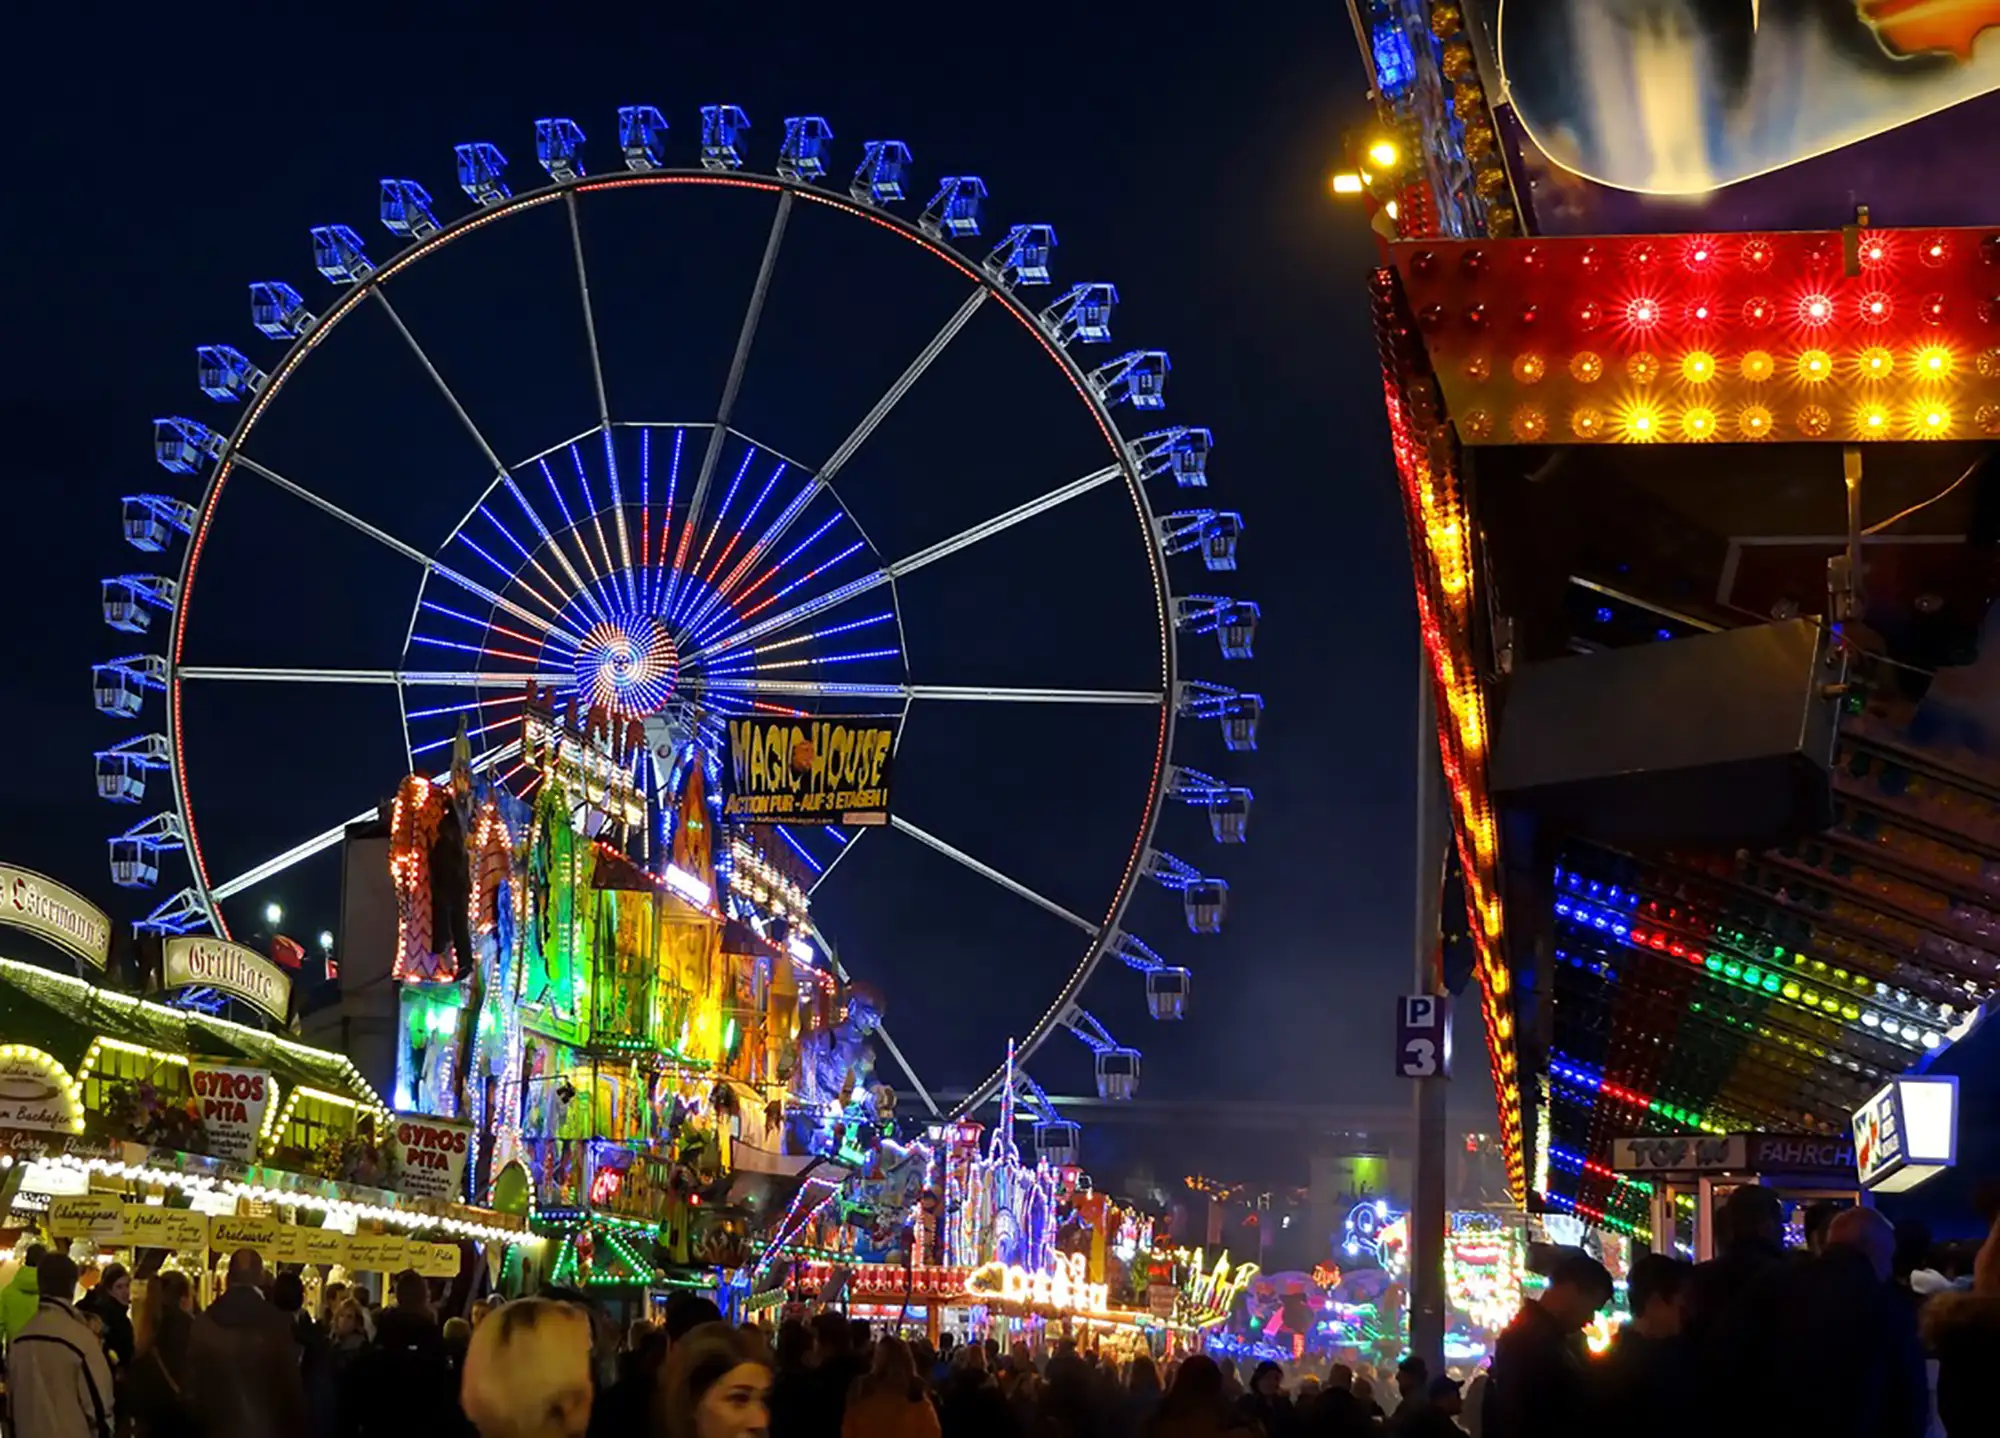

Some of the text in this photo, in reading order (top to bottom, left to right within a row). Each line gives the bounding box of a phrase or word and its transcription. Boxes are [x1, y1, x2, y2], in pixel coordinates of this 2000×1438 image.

[729, 720, 892, 795] MAGIC HOUSE
[724, 793, 769, 815] ACTION
[769, 793, 795, 813] PUR
[800, 791, 825, 812] AUF
[825, 791, 835, 811] 3
[835, 787, 881, 809] ETAGEN
[188, 942, 272, 999] Grillkate
[1410, 999, 1431, 1024] P
[1404, 1038, 1437, 1076] 3
[194, 1069, 264, 1102] GYROS
[204, 1099, 248, 1123] PITA
[397, 1122, 466, 1154] GYROS
[405, 1147, 449, 1171] PITA
